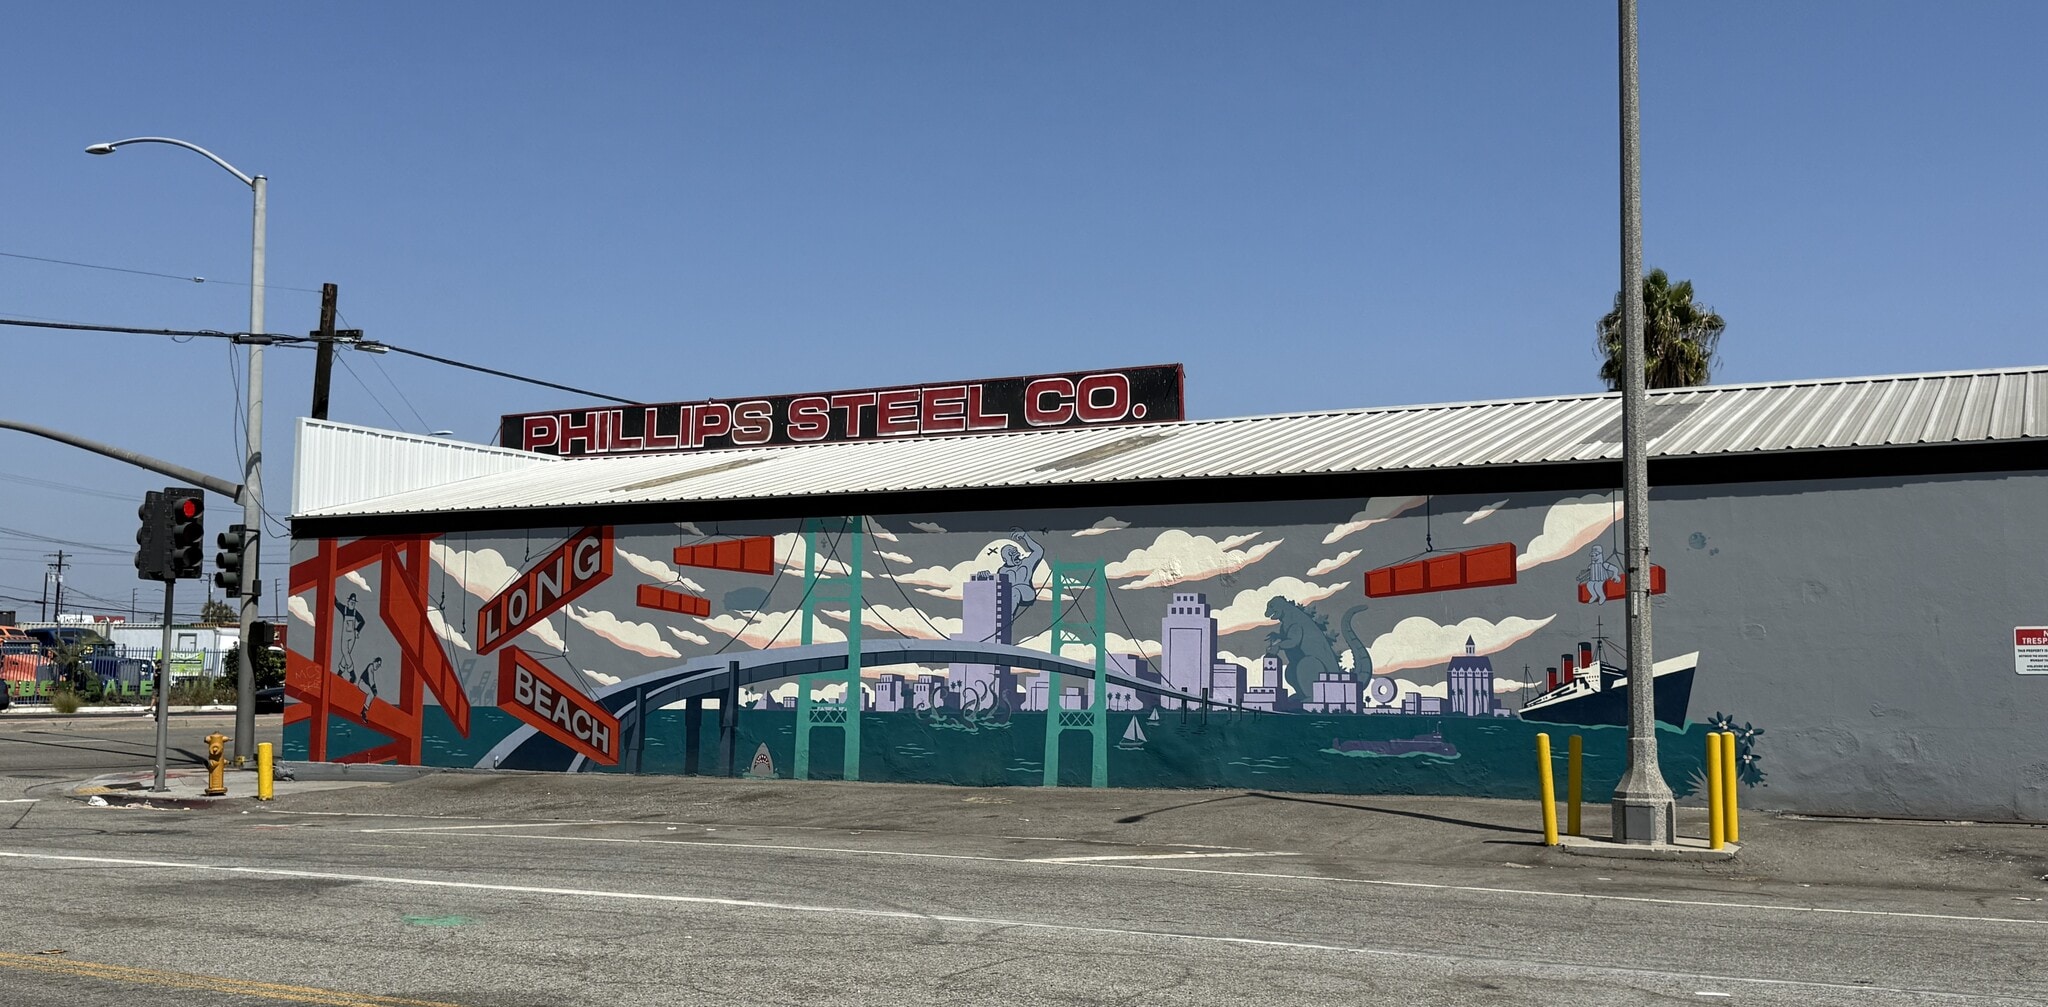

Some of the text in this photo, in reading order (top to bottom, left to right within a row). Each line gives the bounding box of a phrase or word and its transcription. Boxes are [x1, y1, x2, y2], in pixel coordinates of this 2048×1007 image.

[523, 373, 1147, 455] PHILLIPS STEEL CO.
[485, 535, 600, 645] LONG
[515, 665, 610, 754] BEACH
